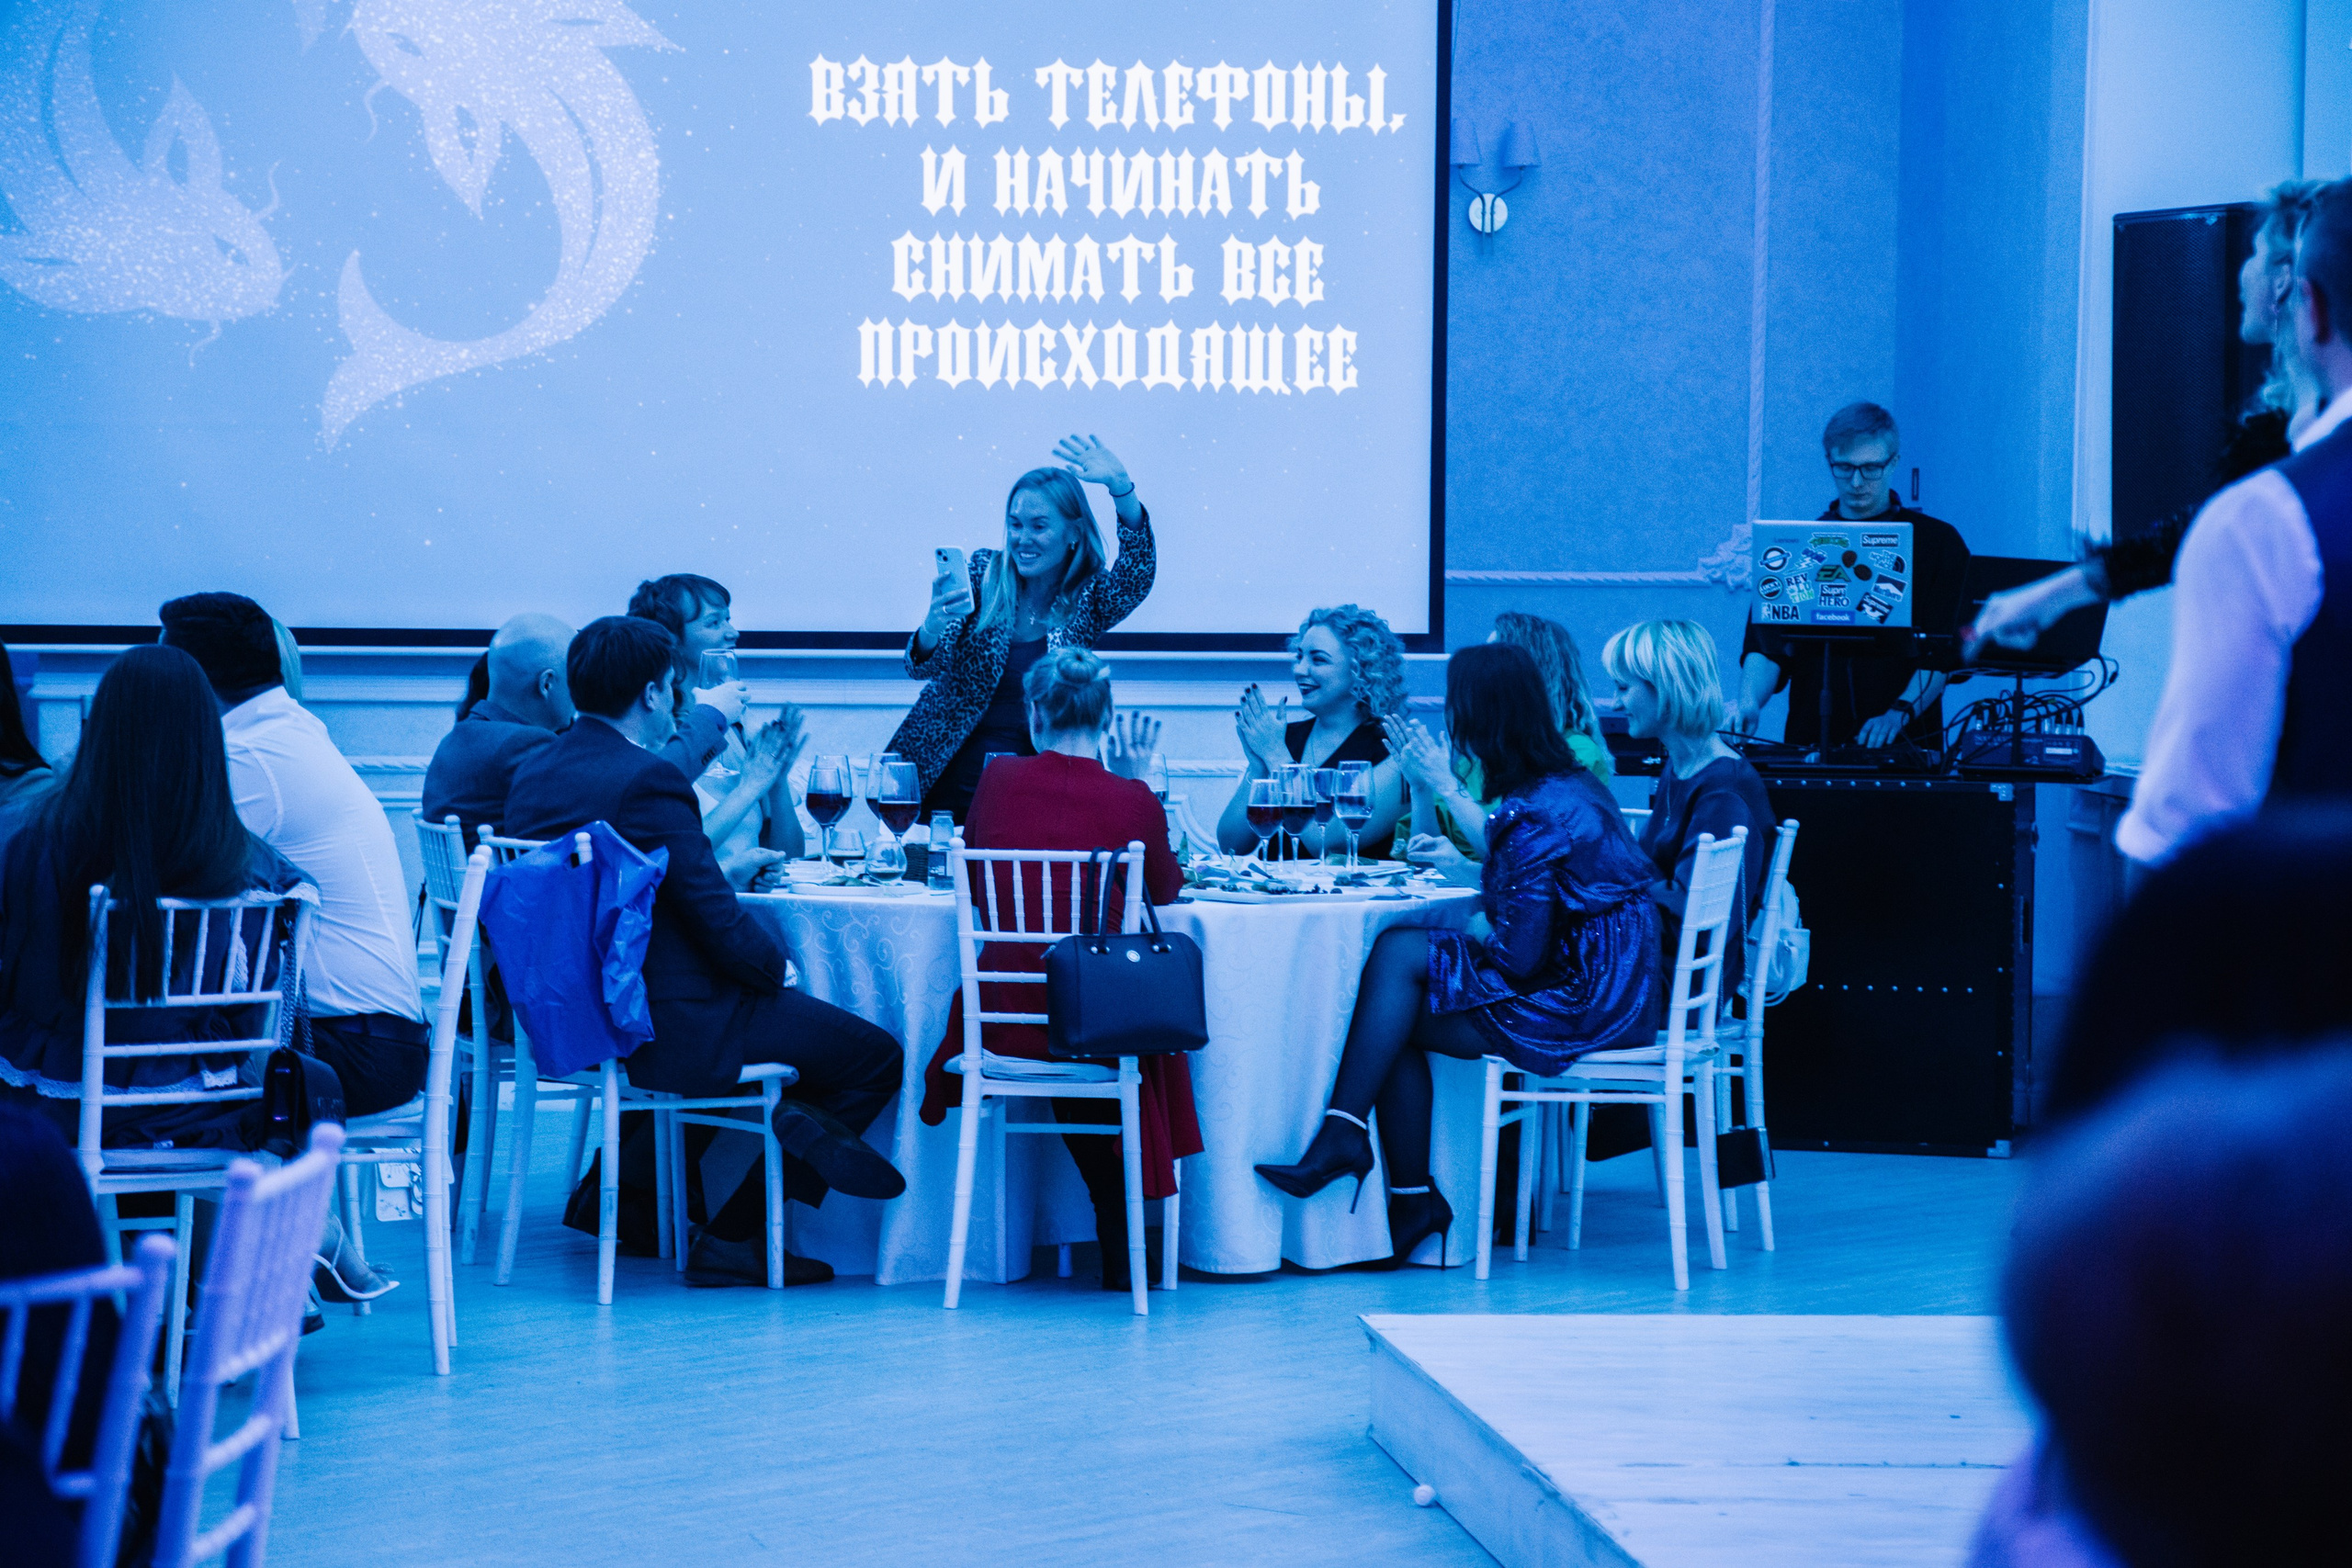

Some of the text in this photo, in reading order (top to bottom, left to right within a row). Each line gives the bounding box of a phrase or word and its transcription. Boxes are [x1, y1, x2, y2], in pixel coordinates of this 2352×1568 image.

[808, 52, 1408, 135] ВЗЯТЬ ТЕЛЕФОНЫ,
[920, 143, 1321, 220] И НАЧИНАТЬ
[891, 230, 1325, 309] СНИМАТЬ ВСЕ
[857, 316, 1359, 396] ПРОИСХОДЯЩЕЕ
[1862, 535, 1898, 546] Supreme
[1785, 573, 1808, 586] REV
[1815, 565, 1851, 582] EA
[1819, 596, 1849, 607] HERO
[1771, 605, 1800, 620] NBA
[1815, 613, 1850, 621] facebook
